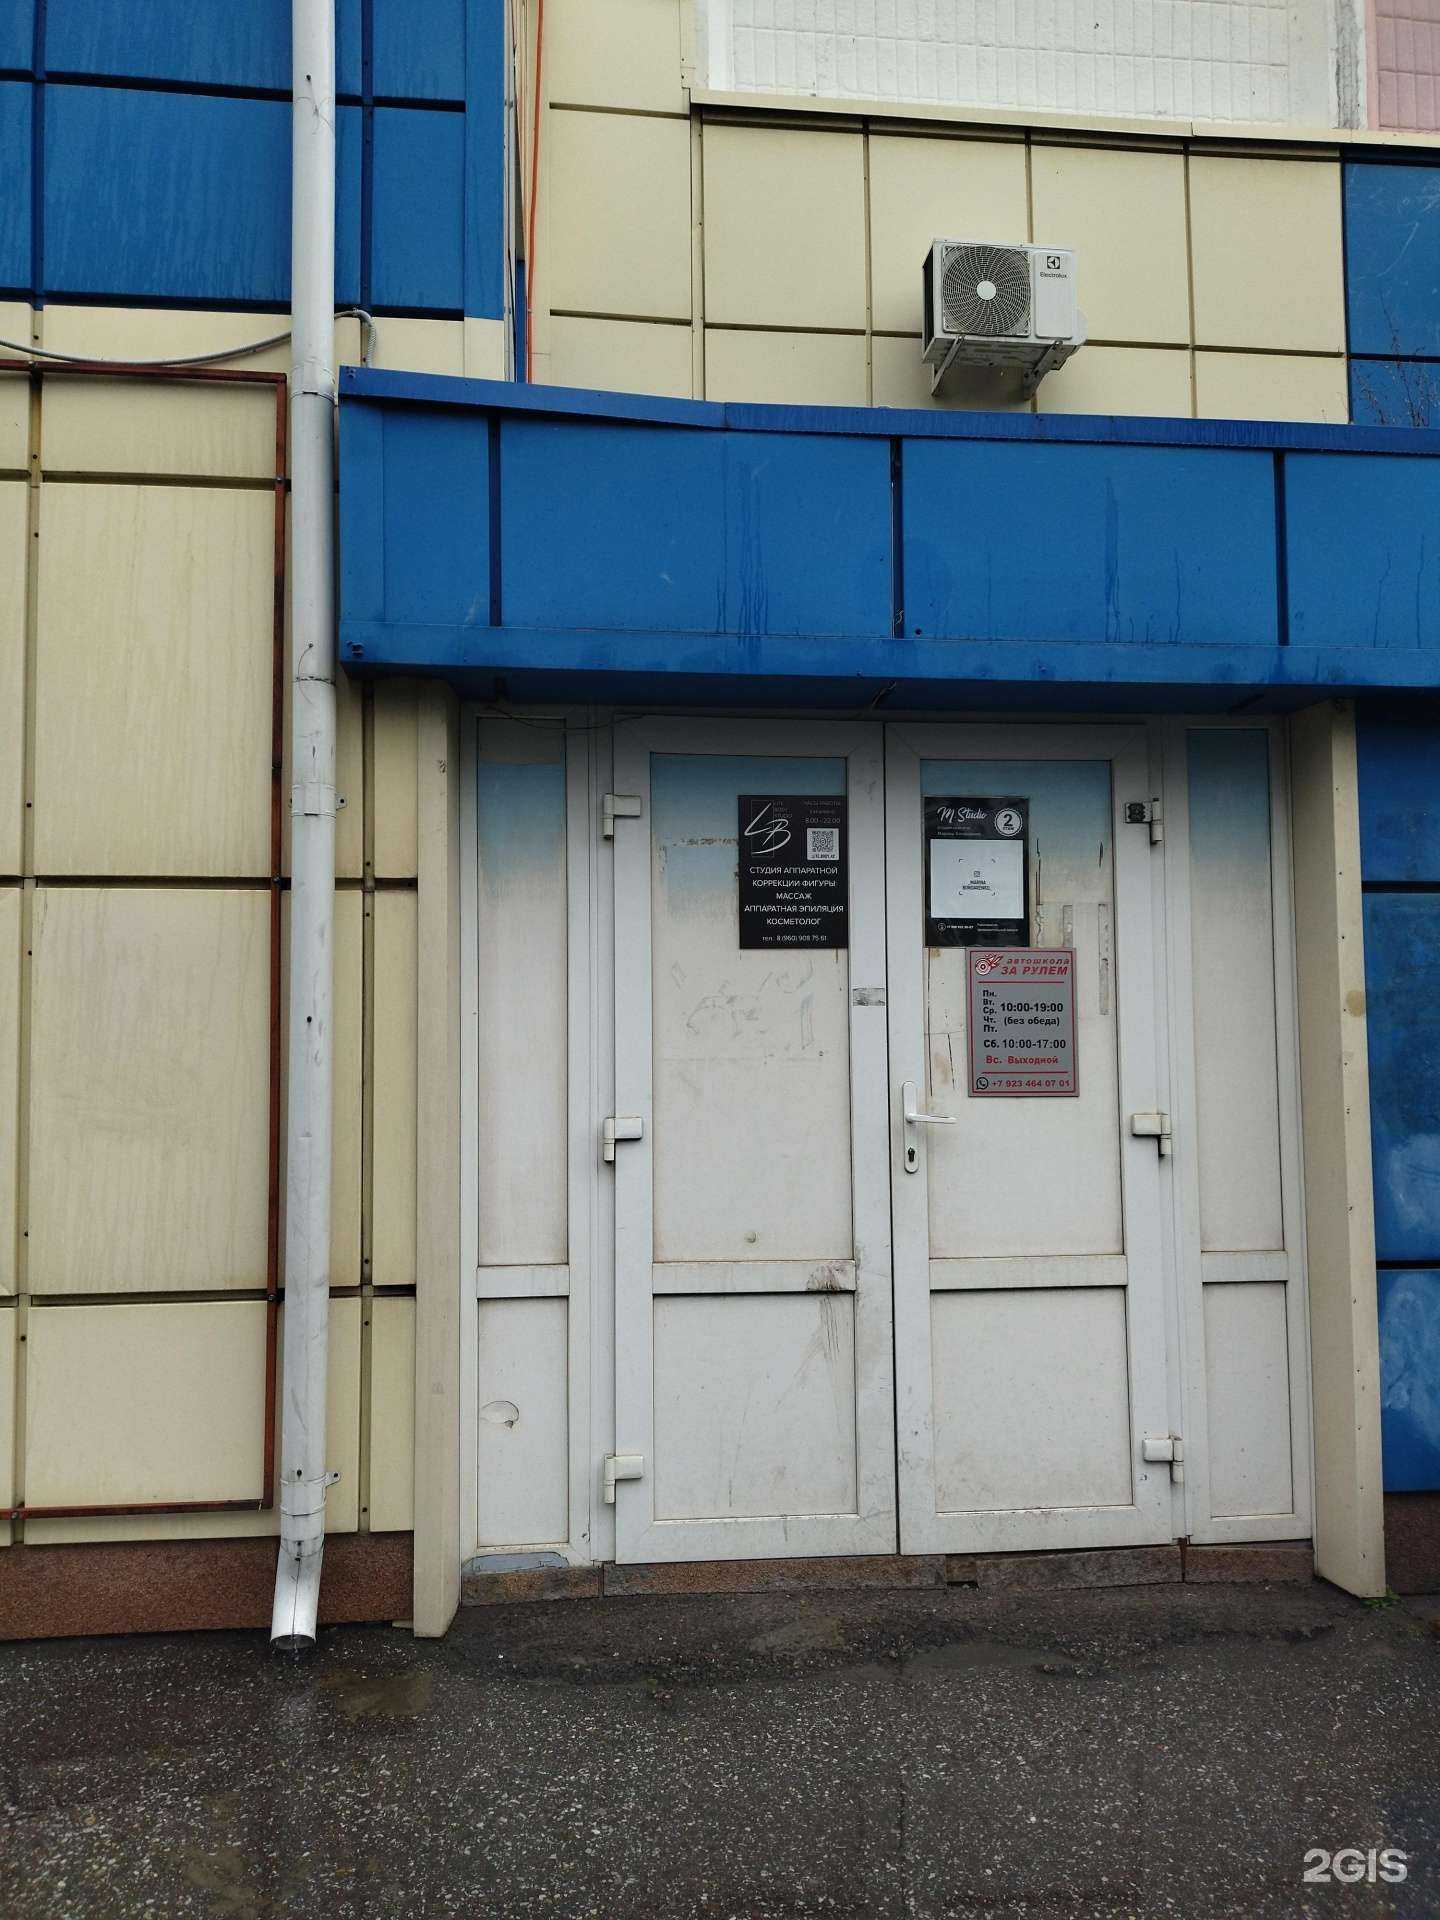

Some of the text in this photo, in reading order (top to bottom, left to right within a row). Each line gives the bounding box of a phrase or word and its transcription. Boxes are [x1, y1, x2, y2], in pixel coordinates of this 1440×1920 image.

[1003, 813, 1013, 827] 2
[749, 866, 838, 875] СТУДИЯ АППАРАТНОЙ
[752, 879, 836, 888] КОРРЕКЦИИ ФИГУРЫ
[776, 892, 812, 900] МАССАЖ
[744, 905, 844, 914] АППАРАТНАЯ ЭПИЛЯЦИЯ
[766, 918, 821, 926] КОСМЕТОЛОГ
[1001, 966, 1068, 976] ЗА РУЛЕМ
[982, 989, 997, 997] Пн.
[983, 998, 995, 1006] Вт.
[982, 1007, 997, 1015] Ср.
[1000, 1002, 1064, 1012] 10:00-19:00
[1004, 1016, 1060, 1026] (без обеда)
[983, 1025, 998, 1033] Пт.
[983, 1039, 1066, 1049] Сб. 10:00-17:00
[985, 1055, 1059, 1065] Вс. Выходной
